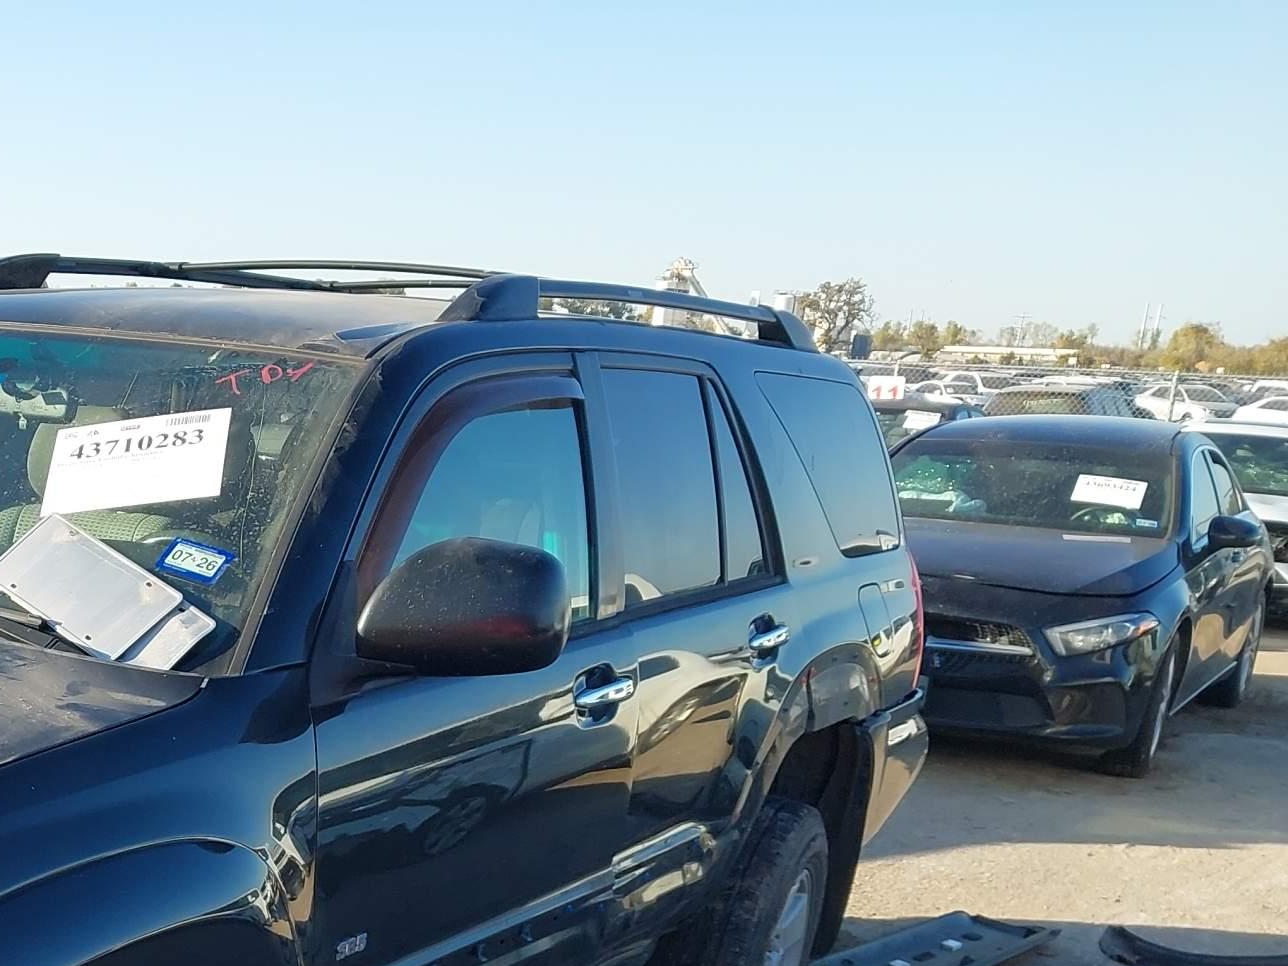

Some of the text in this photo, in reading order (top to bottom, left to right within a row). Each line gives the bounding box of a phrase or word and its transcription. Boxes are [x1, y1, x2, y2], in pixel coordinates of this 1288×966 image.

[70, 428, 204, 460] 43710283
[171, 549, 192, 563] 07
[195, 557, 218, 572] 26
